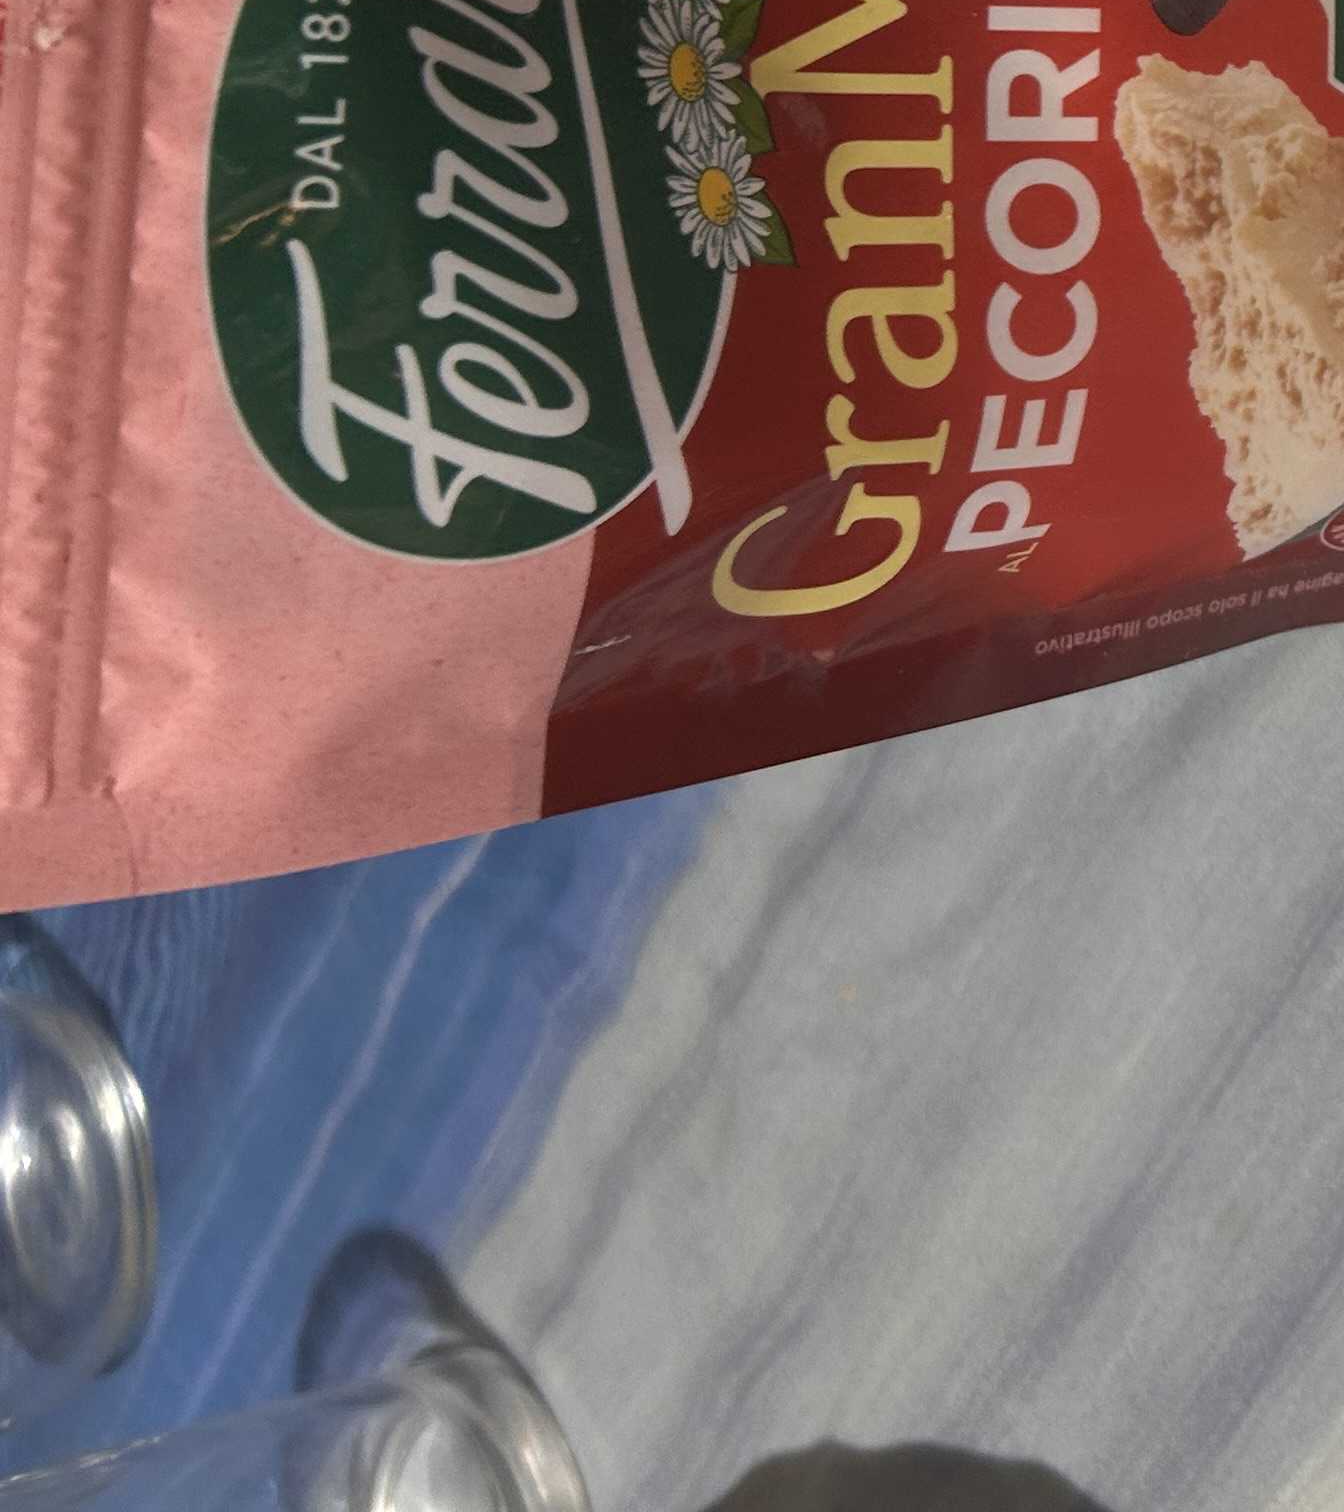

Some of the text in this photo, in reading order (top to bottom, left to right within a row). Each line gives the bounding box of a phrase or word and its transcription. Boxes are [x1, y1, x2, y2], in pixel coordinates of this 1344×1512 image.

[290, 98, 346, 212] DAL
[997, 542, 1040, 573] AL
[1208, 592, 1248, 616] solo
[1251, 588, 1263, 608] il
[1267, 581, 1290, 601] ha
[1146, 601, 1205, 630] scopo
[1035, 618, 1141, 656] illustrativo
